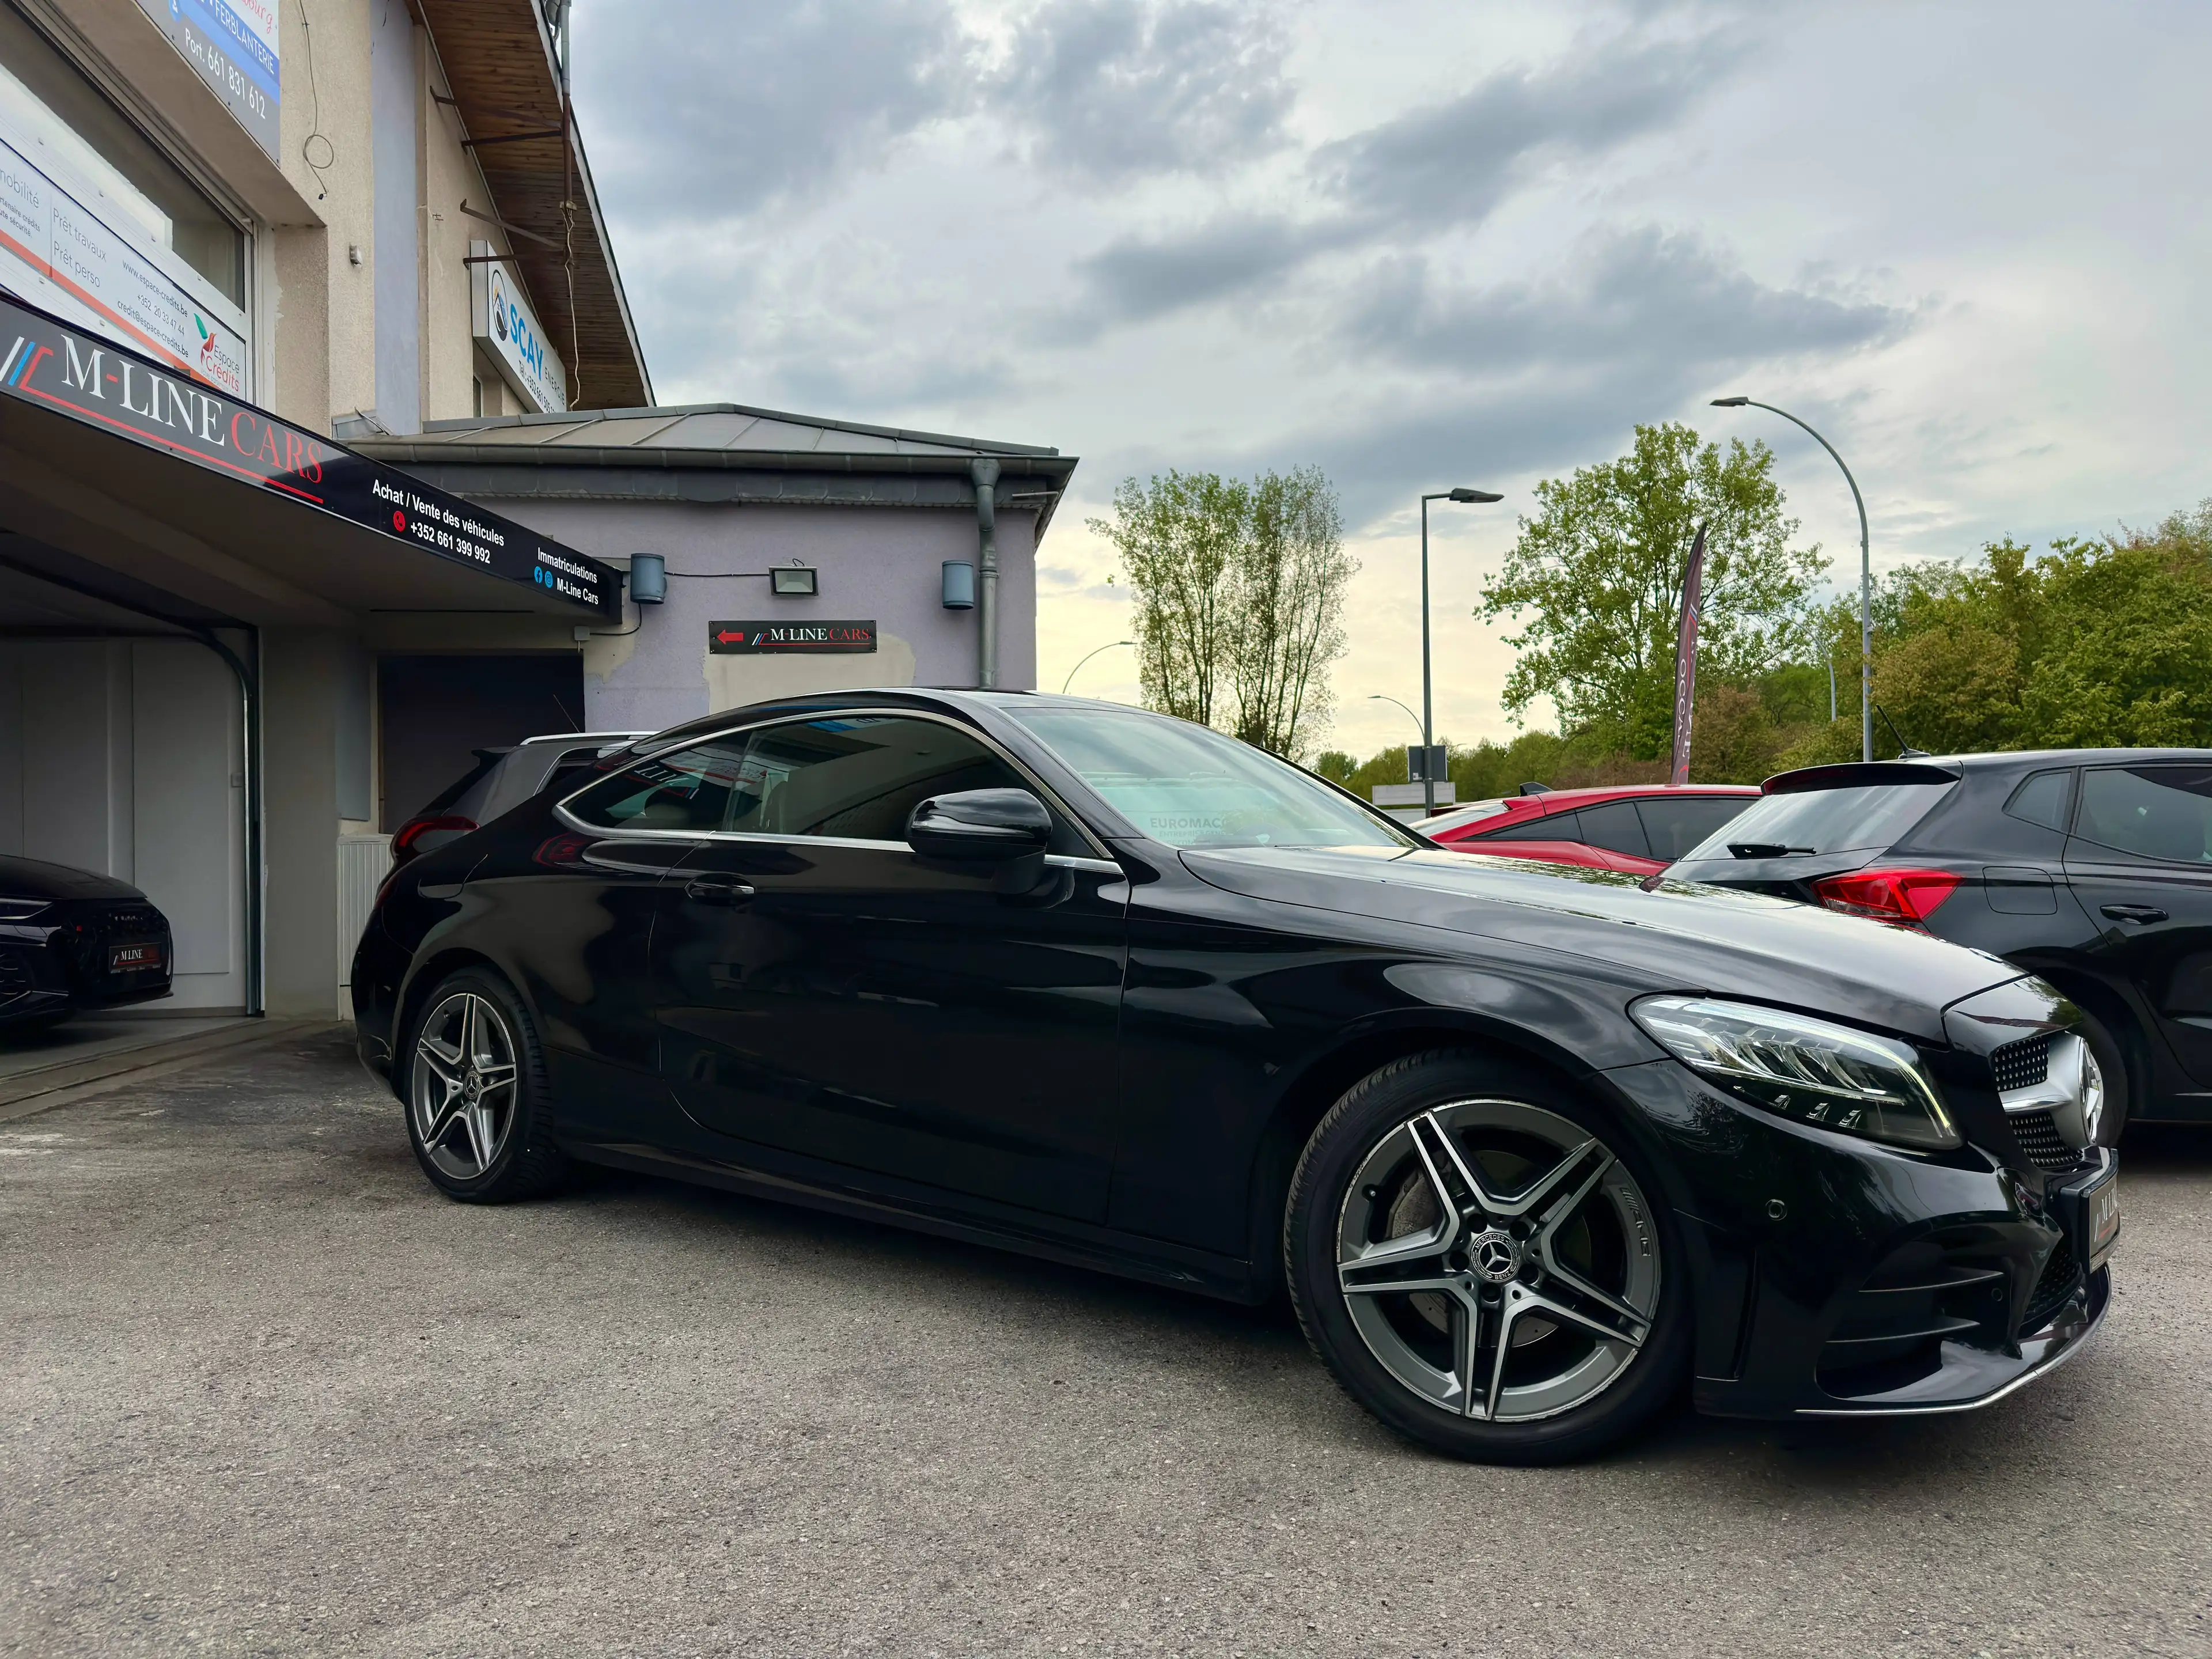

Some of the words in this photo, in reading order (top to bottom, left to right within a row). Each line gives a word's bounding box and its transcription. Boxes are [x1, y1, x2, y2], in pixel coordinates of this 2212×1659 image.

[215, 0, 274, 75] FERBLANTERIE
[185, 28, 205, 62] Port.
[208, 46, 224, 81] 661
[229, 65, 245, 101] 831
[249, 86, 266, 119] 612
[22, 213, 41, 232] crédits
[54, 207, 72, 236] Prêt
[74, 229, 107, 263] travaux
[54, 241, 73, 268] Prêt
[75, 262, 100, 287] perso
[123, 260, 188, 317] www.espace-credits.be
[118, 300, 189, 358] credit@espace-credits.be
[137, 294, 151, 311] +352
[154, 305, 161, 318] 20
[162, 312, 169, 324] 33
[170, 320, 177, 330] 47
[178, 324, 185, 337] 44
[214, 344, 240, 374] Espace
[510, 303, 543, 381] SCAY
[206, 355, 240, 392] Crédits
[60, 334, 225, 446] M-LINE
[231, 412, 323, 484] CARS
[373, 479, 404, 506] Achat
[412, 494, 441, 521] Vente
[442, 509, 460, 528] des
[461, 518, 505, 547] véhicules
[410, 521, 434, 543] +352
[437, 530, 453, 550] 661
[456, 539, 472, 557] 399
[474, 547, 490, 564] 992
[537, 547, 597, 584] Immatriculations
[556, 577, 581, 599] M-Line
[583, 587, 599, 605] Cars
[770, 628, 827, 641] M-LINE
[830, 628, 870, 641] CARS
[1677, 658, 1687, 747] OCCA
[1475, 1234, 1505, 1249] MERCEDES
[1494, 1271, 1511, 1280] BENZ
